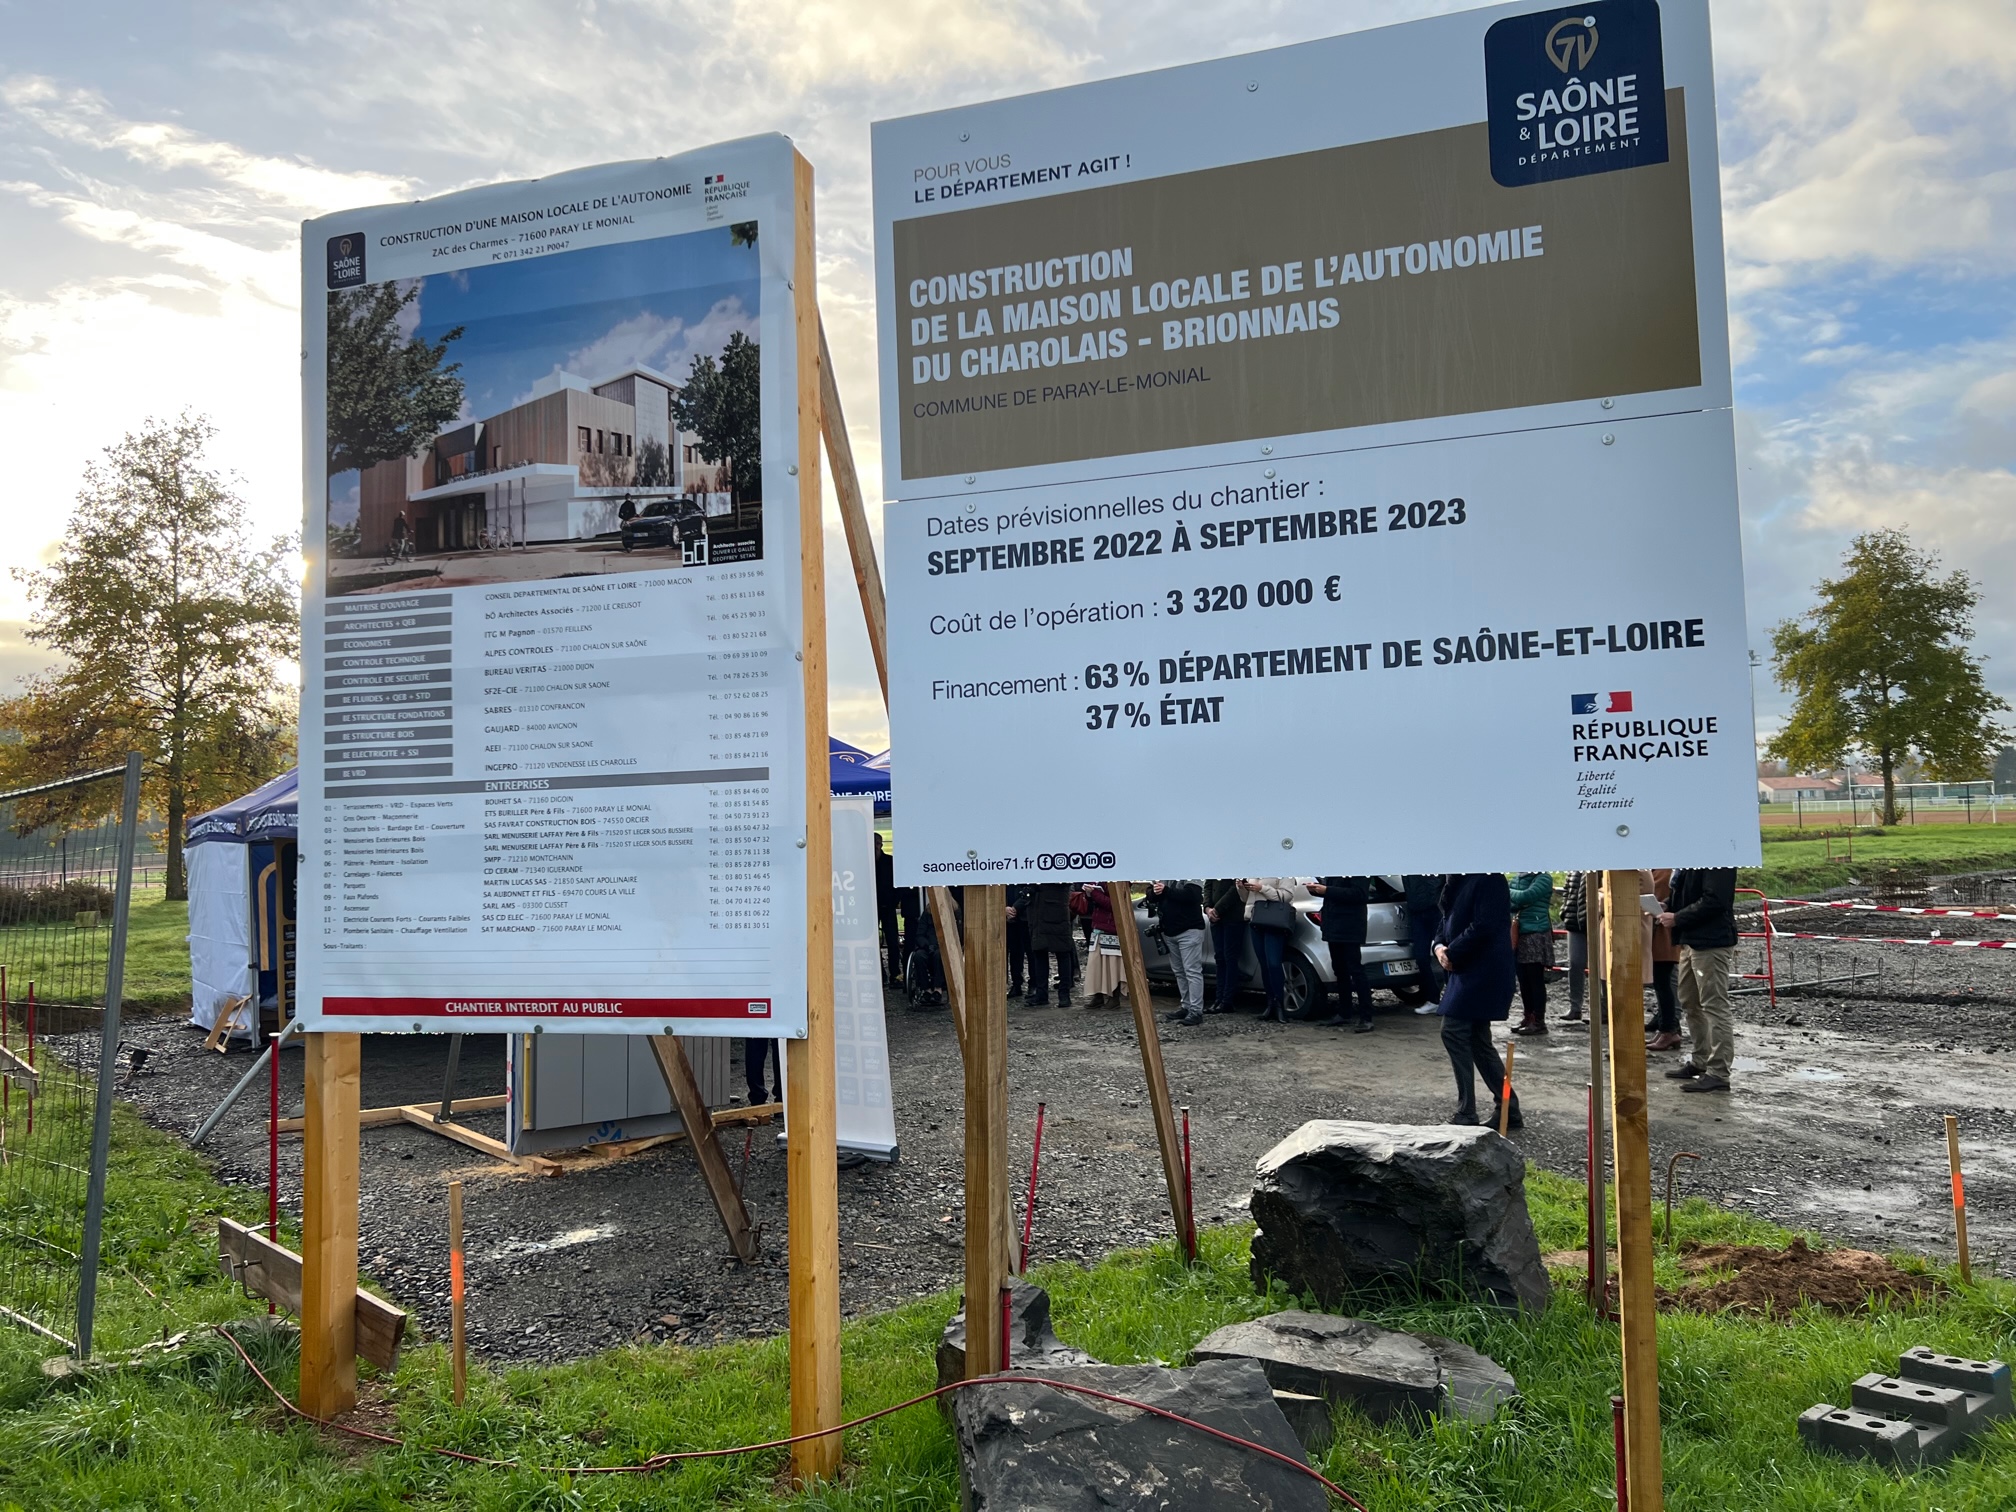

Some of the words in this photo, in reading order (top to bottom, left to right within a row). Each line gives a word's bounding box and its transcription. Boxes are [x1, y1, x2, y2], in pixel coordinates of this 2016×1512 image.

[1516, 74, 1638, 121] SAÔNE
[1519, 126, 1531, 142] &
[1538, 107, 1640, 151] LOIRE
[1518, 137, 1641, 166] DÉPARTEMENT
[914, 163, 959, 182] POUR
[964, 154, 1010, 173] VOUS
[705, 181, 750, 195] RÉPUBLIQUE
[914, 187, 934, 203] LE
[940, 165, 1071, 198] DÉPARTEMENT
[1078, 156, 1120, 175] AGIT
[705, 190, 747, 203] FRANÇAISE
[380, 224, 461, 246] CONSTRUCTION
[465, 217, 496, 231] D'UNE
[501, 210, 543, 225] MAISON
[547, 201, 588, 217] LOCALE
[593, 197, 607, 209] DE
[612, 184, 691, 205] L'AUTONOMIE
[432, 246, 449, 257] ZAC
[451, 244, 466, 253] des
[469, 238, 508, 250] Charmes
[518, 229, 546, 241] 71600
[549, 224, 578, 236] PARAY
[582, 221, 592, 230] LE
[596, 215, 634, 227] MONIAL
[492, 252, 501, 260] PC
[503, 250, 516, 258] 071
[520, 247, 533, 256] 342
[536, 245, 544, 253] 21
[546, 240, 569, 251] P0047
[333, 256, 361, 270] SAÔNE
[338, 266, 361, 279] LOIRE
[910, 249, 1132, 306] CONSTRUCTION
[911, 314, 948, 345] DE
[958, 308, 994, 339] LA
[1002, 290, 1120, 332] MAISON
[1132, 270, 1250, 313] LOCALE
[1261, 262, 1303, 295] DE
[1314, 226, 1543, 286] L’AUTONOMIE
[912, 353, 950, 383] DU
[960, 329, 1127, 376] CHAROLAIS
[1162, 298, 1339, 349] BRIONNAIS
[913, 393, 1007, 417] COMMUNE
[1013, 388, 1036, 405] DE
[1042, 367, 1210, 400] PARAY-LE-MONIAL
[927, 510, 988, 536] Dates
[997, 497, 1164, 533] prévisionnelles
[1172, 490, 1201, 510] du
[1210, 480, 1309, 506] chantier
[928, 538, 1084, 574] SEPTEMBRE
[1093, 530, 1162, 559] 2022
[1171, 522, 1191, 552] À
[1200, 507, 1377, 548] SEPTEMBRE
[1388, 498, 1466, 530] 2023
[485, 592, 511, 600] CONSEIL
[513, 588, 569, 598] DEPARTEMENTAL
[582, 584, 604, 592] SAÔNE
[617, 581, 636, 589] LOIRE
[498, 610, 538, 618] Architectes
[612, 601, 641, 609] CREUSOT
[930, 613, 981, 634] Coût
[989, 610, 1016, 630] de
[1024, 601, 1143, 629] l’opération
[1166, 590, 1183, 615] 3
[1193, 584, 1247, 612] 320
[1257, 578, 1312, 606] 000
[1324, 575, 1340, 601] €
[508, 646, 553, 655] CONTROLES
[582, 642, 609, 650] CHALON
[625, 639, 646, 647] SAÔNE
[932, 674, 1066, 698] Financement
[1159, 644, 1372, 683] DÉPARTEMENT
[1382, 640, 1422, 668] DE
[1433, 619, 1704, 663] SAÔNE-ET-LOIRE
[484, 668, 513, 676] BUREAU
[515, 665, 546, 673] VERITAS
[484, 705, 512, 714] SABRES
[1160, 693, 1224, 725] ÉTAT
[484, 724, 519, 733] GAUJARD
[526, 723, 546, 731] 84000
[1572, 717, 1717, 739] RÉPUBLIQUE
[1574, 740, 1708, 761] FRANÇAISE
[485, 779, 549, 791] ENTREPRISES
[1576, 770, 1616, 782] Liberté
[1577, 784, 1617, 798] Égalité
[1578, 798, 1634, 809] Fraternité
[923, 857, 1035, 873] saoneetloire71.fr
[445, 1002, 502, 1012] CHANTIER
[505, 1002, 558, 1012] INTERDIT
[562, 1002, 578, 1012] AU
[582, 1002, 622, 1013] PUBLIC
